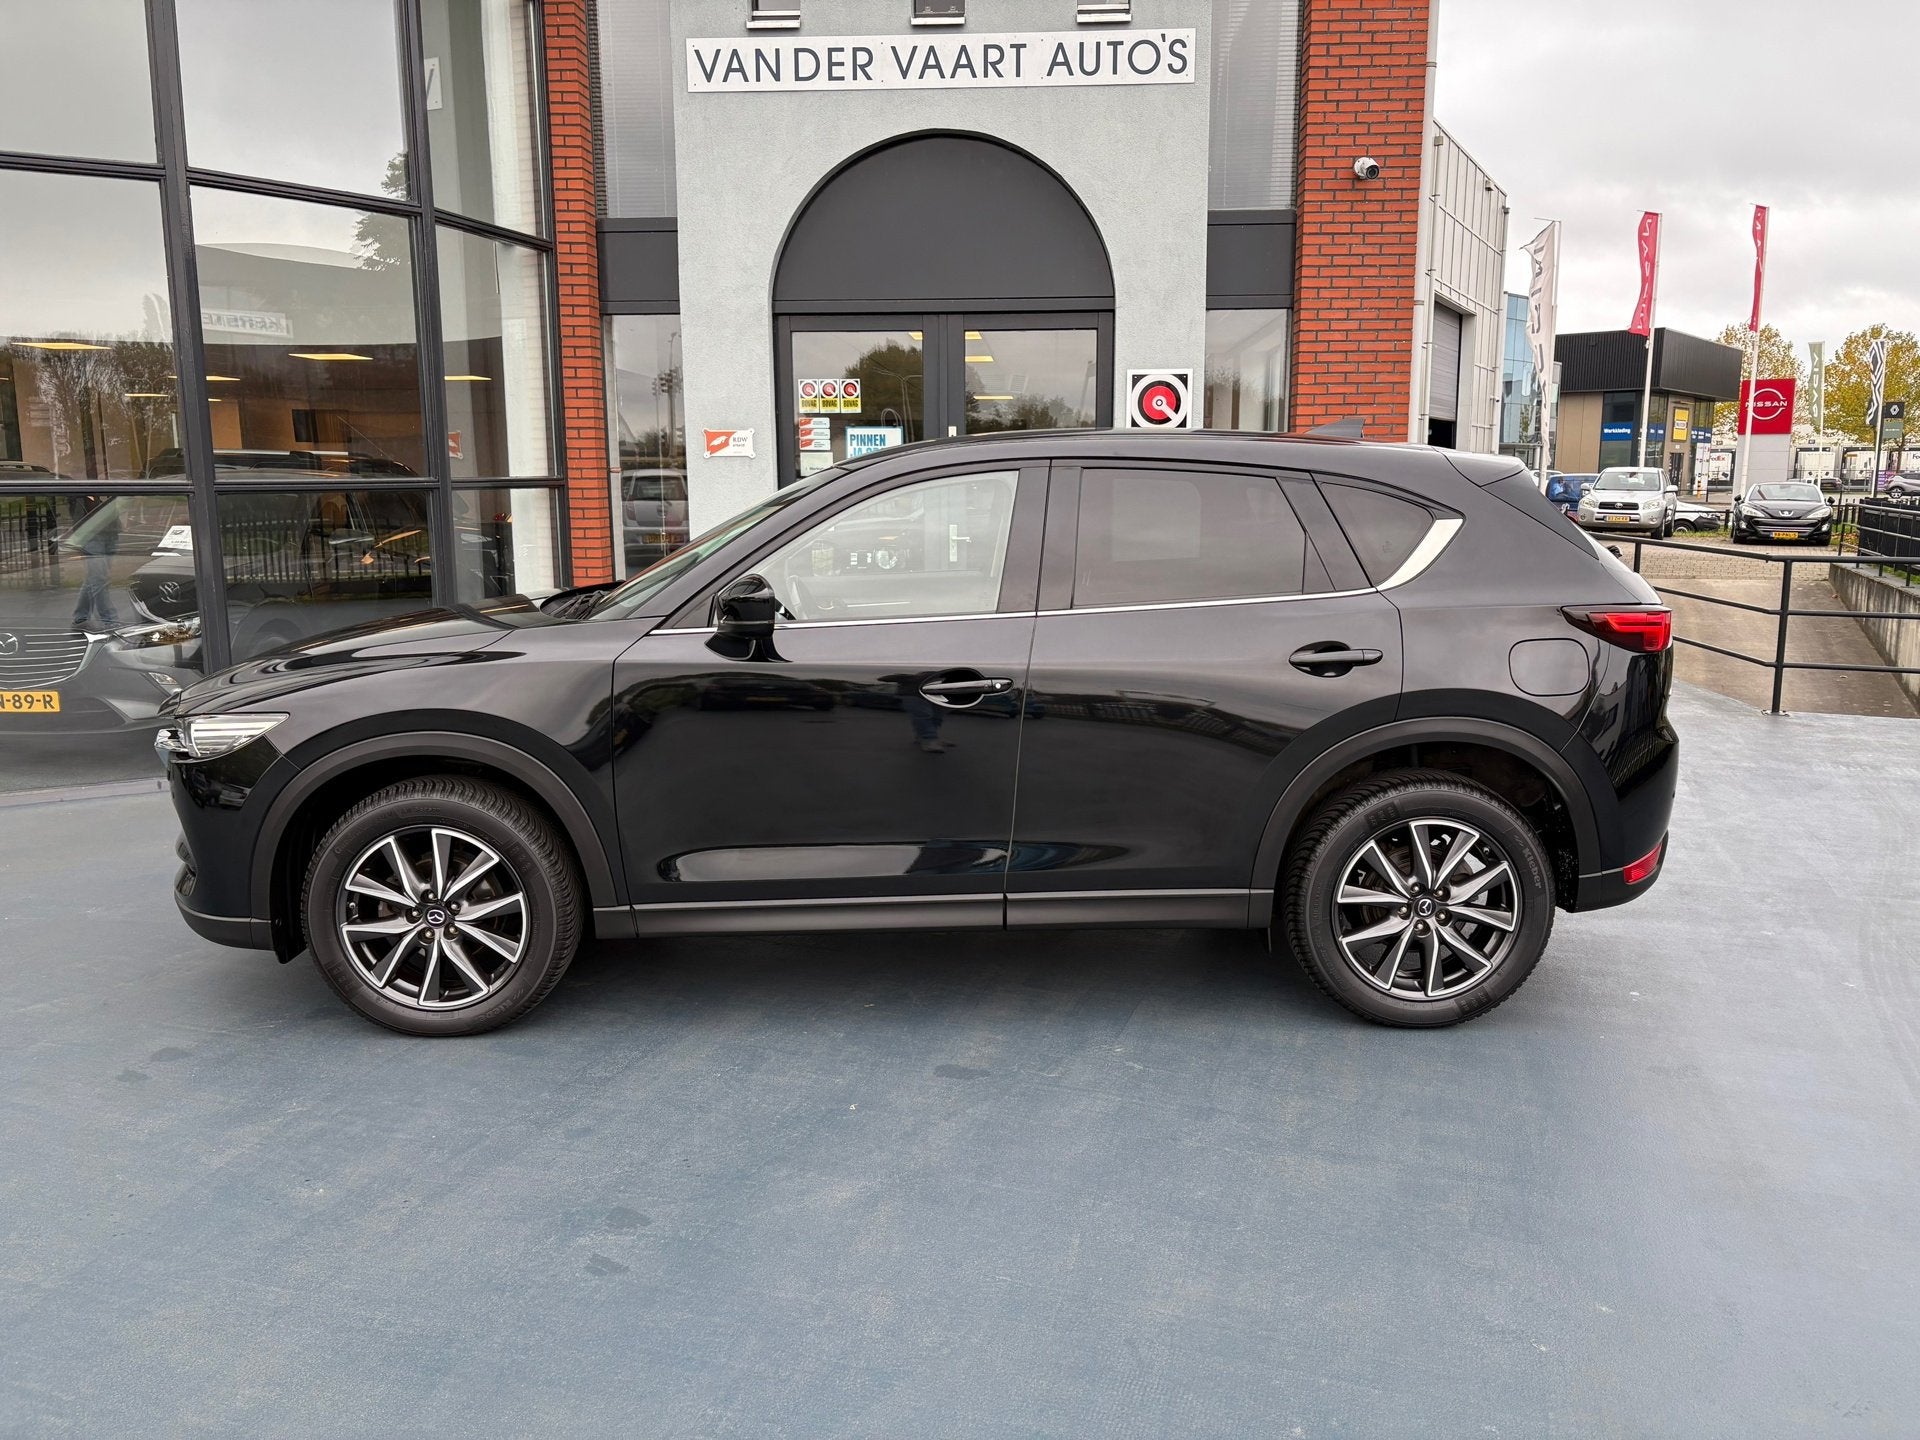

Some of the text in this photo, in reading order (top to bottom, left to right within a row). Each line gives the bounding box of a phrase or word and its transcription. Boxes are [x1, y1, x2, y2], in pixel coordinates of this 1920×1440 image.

[694, 33, 1188, 84] VAN DER VAART AUTO'S
[802, 399, 817, 408] BOVAG
[822, 399, 837, 408] BOVAG
[843, 399, 859, 408] BOVAG
[849, 434, 886, 447] PINNEN
